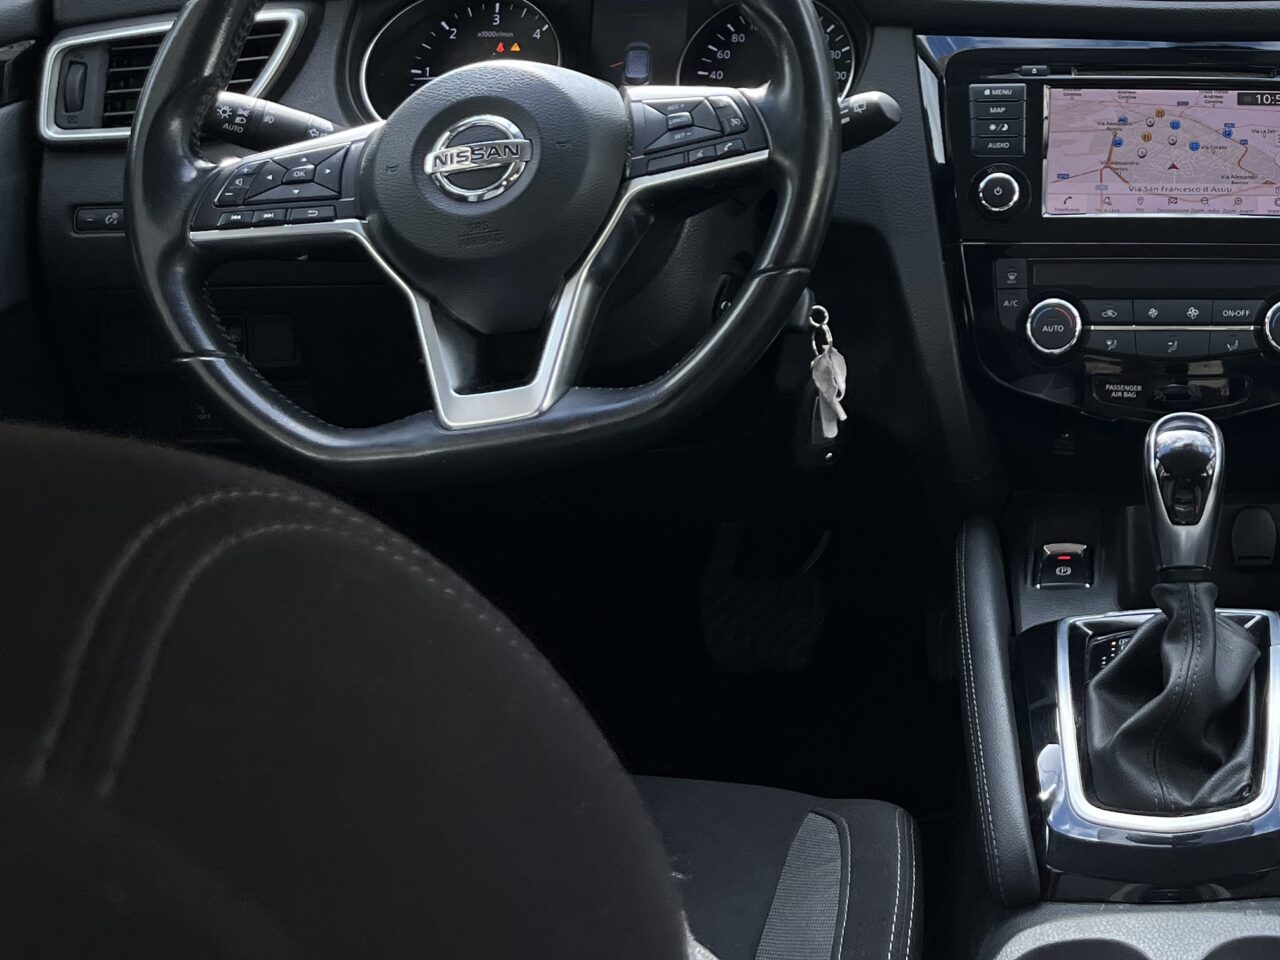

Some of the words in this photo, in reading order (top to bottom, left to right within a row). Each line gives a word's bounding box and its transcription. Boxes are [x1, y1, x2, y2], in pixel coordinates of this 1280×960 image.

[492, 14, 500, 25] 3
[449, 28, 457, 39] 2
[533, 28, 541, 39] 4
[731, 33, 745, 43] 80
[717, 49, 731, 59] 60
[709, 71, 724, 80] 40
[222, 122, 244, 133] AUTO
[433, 143, 520, 169] NISSAN
[1161, 185, 1201, 193] Francesco
